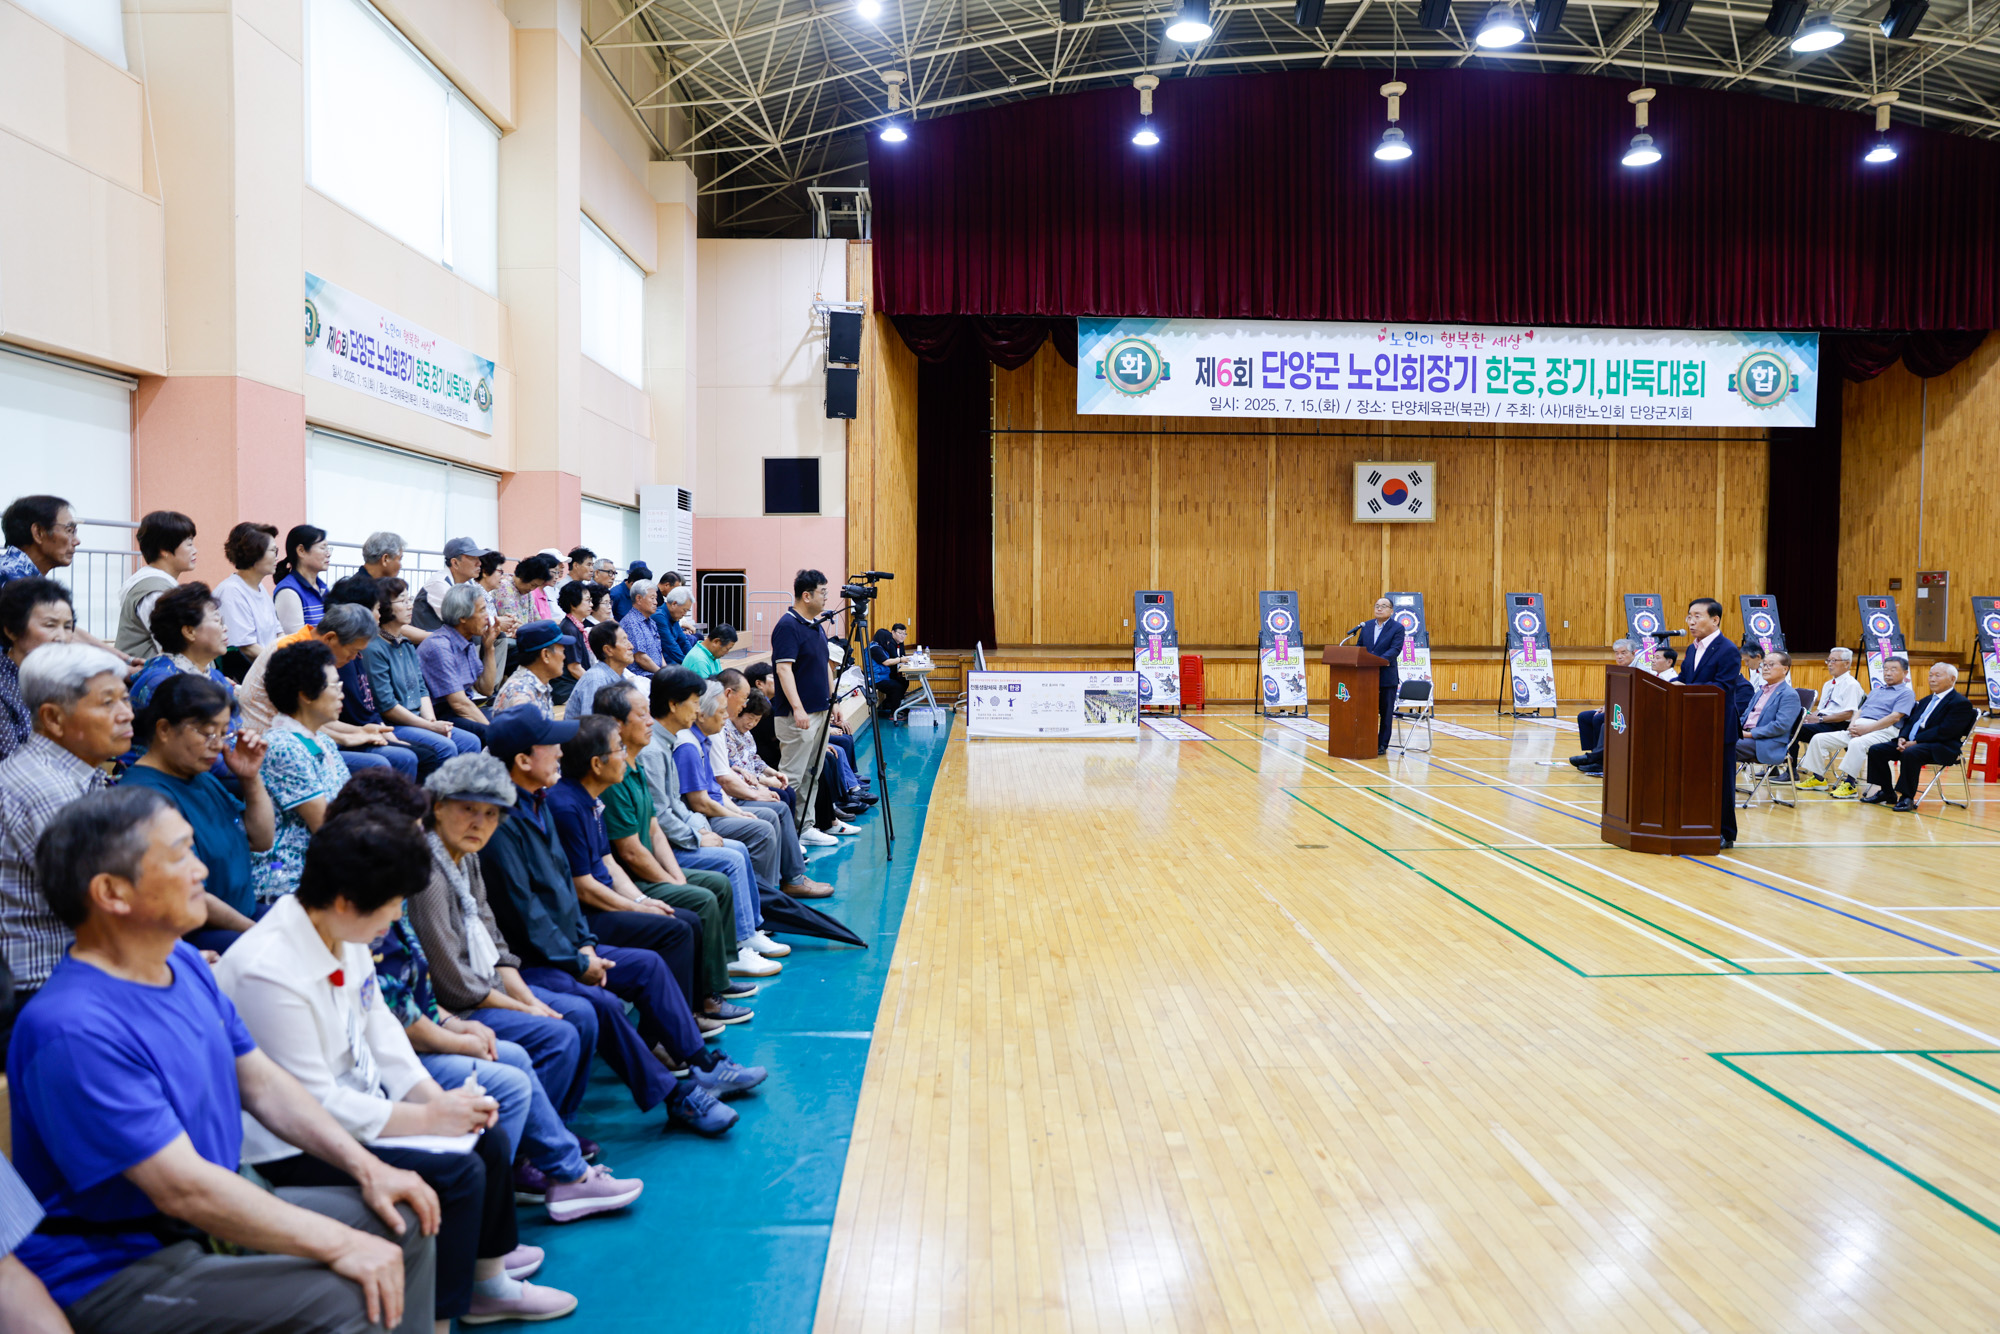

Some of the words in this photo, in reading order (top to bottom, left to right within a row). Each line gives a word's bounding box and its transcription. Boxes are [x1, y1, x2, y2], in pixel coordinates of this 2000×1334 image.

[1389, 331, 1434, 348] 노인이
[1440, 332, 1486, 350] 행복한
[1492, 333, 1523, 350] 세상
[327, 325, 349, 358] 제6회
[350, 329, 375, 370] 단양군
[377, 341, 415, 384] 노인회장기
[1119, 354, 1146, 380] 화
[1195, 356, 1253, 388] 제6회
[1261, 351, 1340, 390] 단양군
[1348, 353, 1477, 394] 노인회장기
[1485, 355, 1706, 398] 한궁,장기,바둑대회
[1751, 365, 1778, 392] 합
[1209, 397, 1239, 412] 일시:
[1244, 398, 1280, 412] 2025.
[1284, 399, 1295, 412] 7.
[1300, 398, 1341, 414] 15.(화)
[1356, 400, 1386, 413] 장소:
[1391, 400, 1490, 418] 단양체육관(북관)
[1506, 404, 1535, 418] 주최:
[1540, 404, 1626, 420] (사)대한노인회
[1630, 405, 1693, 421] 단양군지회
[1157, 595, 1164, 604] 0
[1528, 597, 1534, 606] 0
[1646, 598, 1653, 606] 0
[1761, 599, 1768, 607] 0
[1879, 600, 1886, 608] 0
